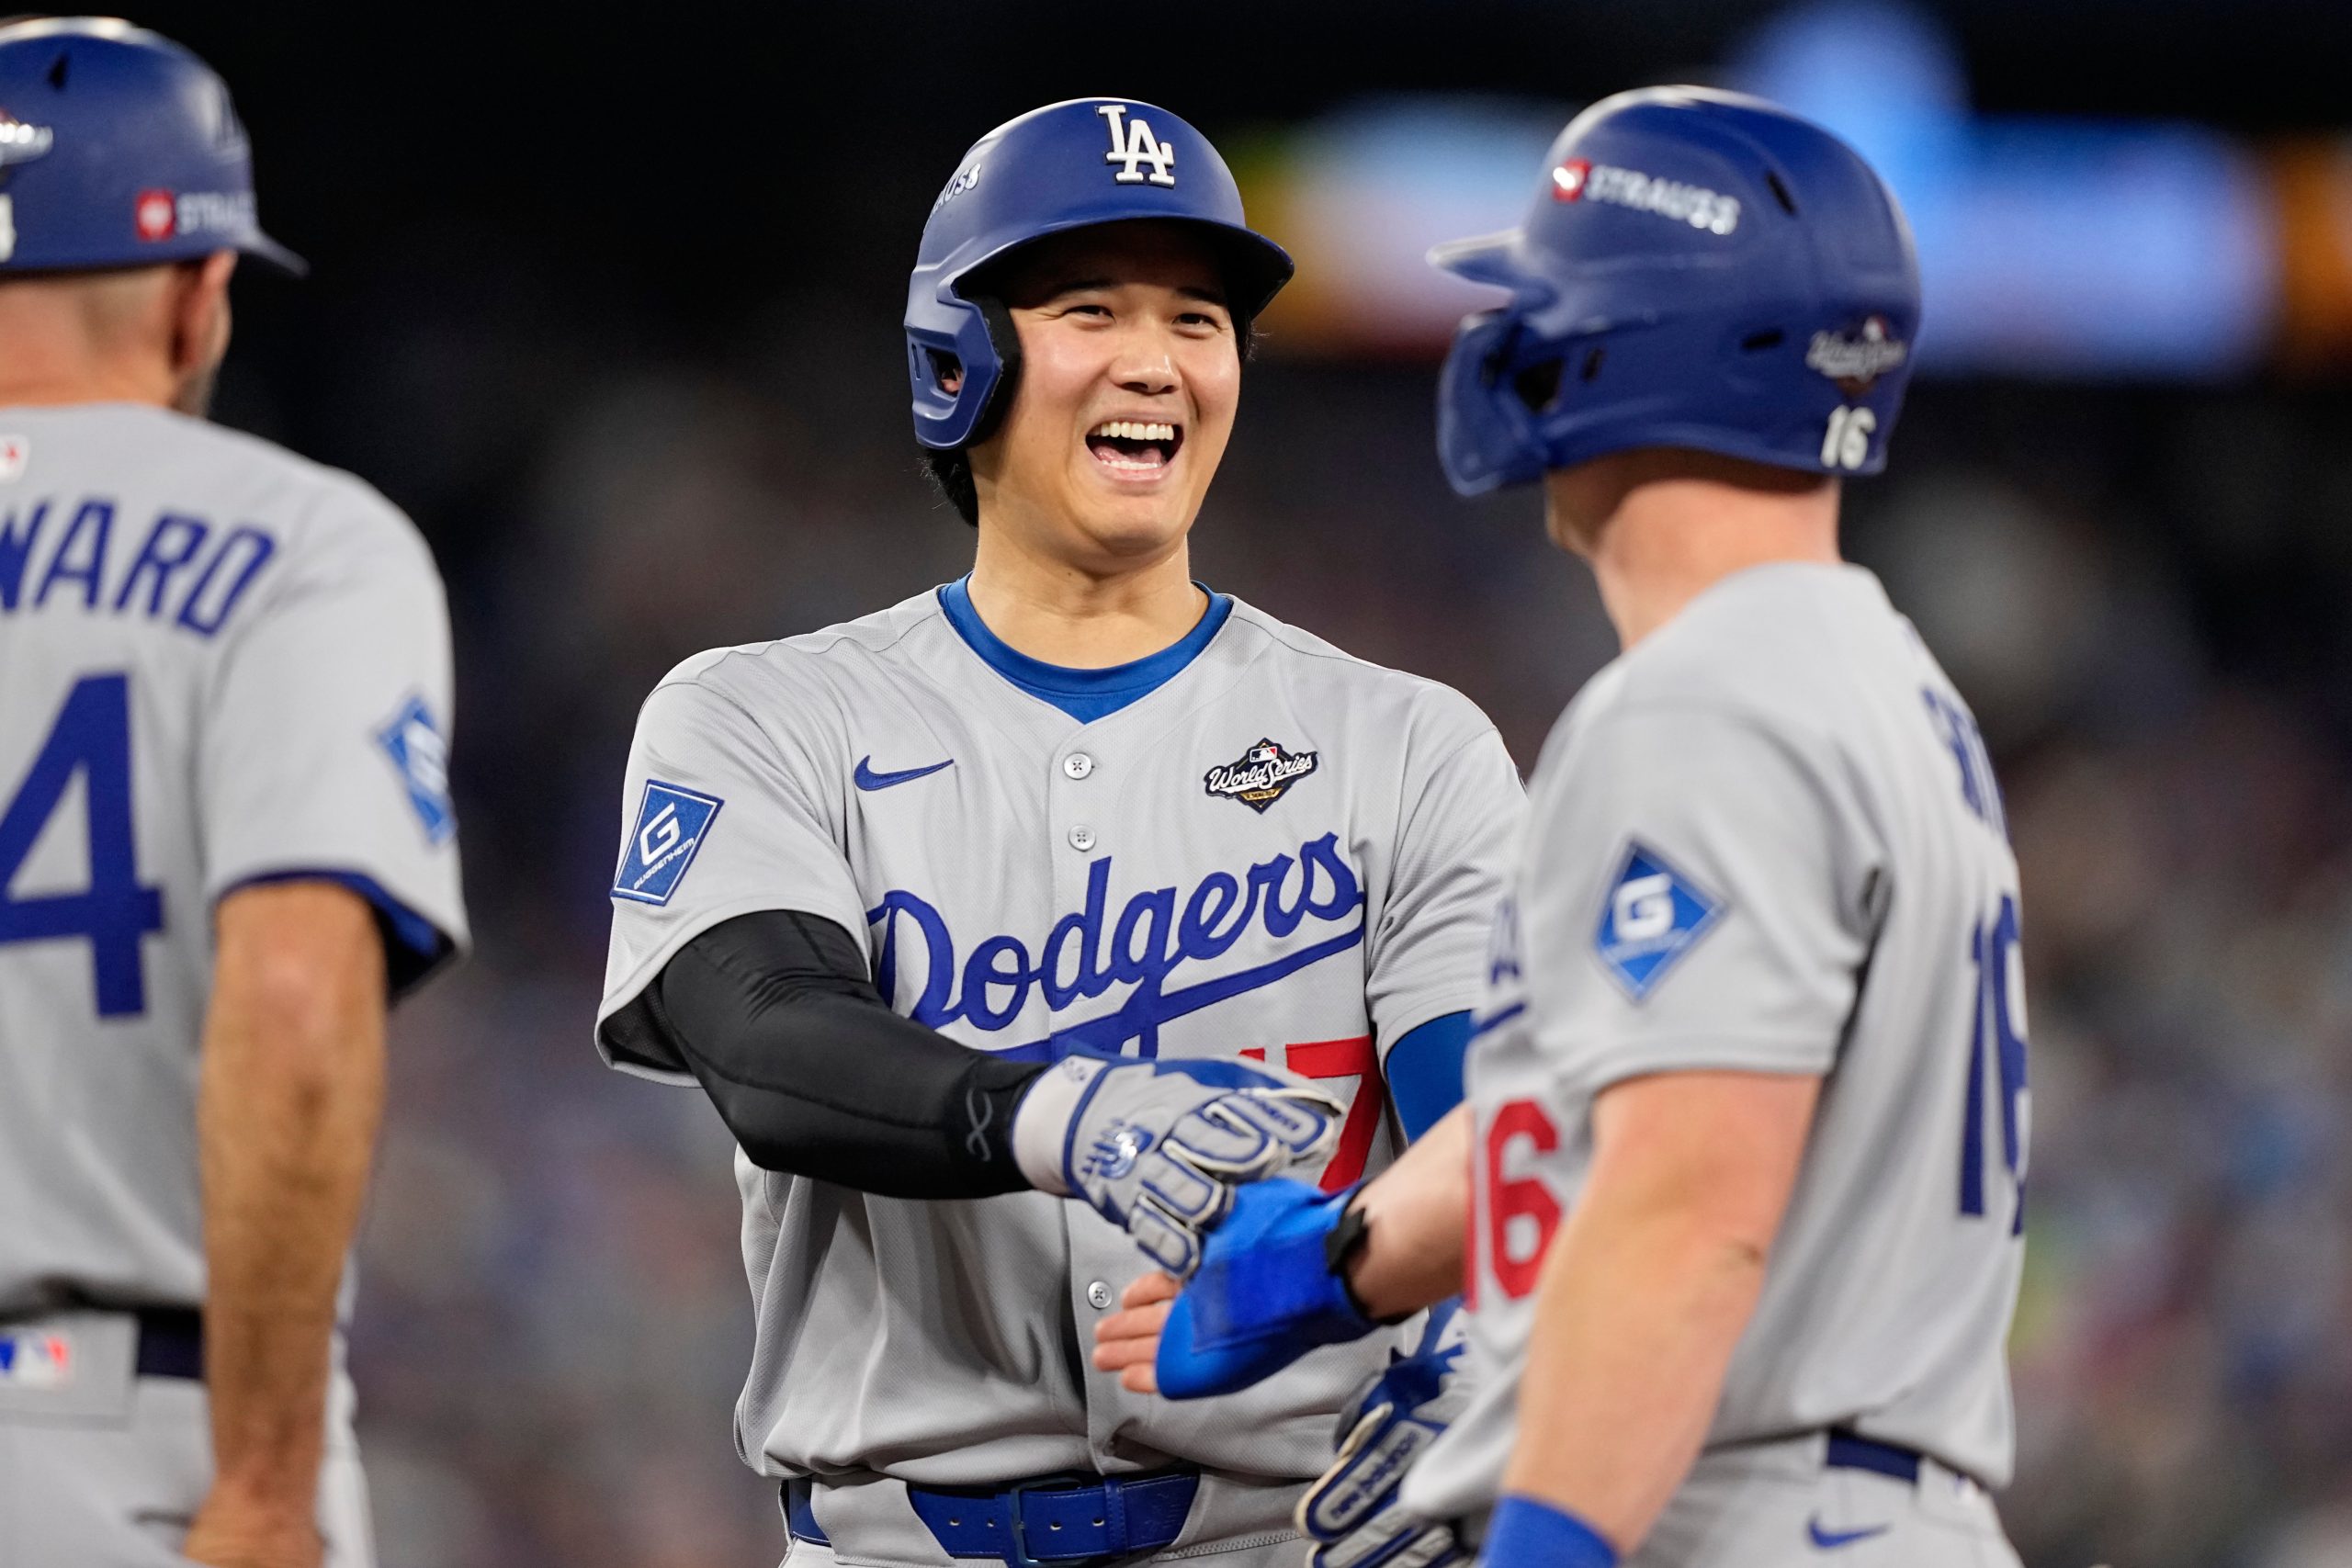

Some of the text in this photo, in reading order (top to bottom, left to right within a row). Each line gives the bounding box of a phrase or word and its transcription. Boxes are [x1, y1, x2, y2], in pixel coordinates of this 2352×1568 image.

[1098, 105, 1175, 186] LA
[1587, 164, 1740, 235] STRAUSS
[1819, 404, 1877, 470] 16
[1208, 754, 1313, 793] World Series
[0, 671, 164, 1020] 4
[633, 837, 696, 891] GUGGENHEIM
[865, 831, 1366, 1062] Dodgers
